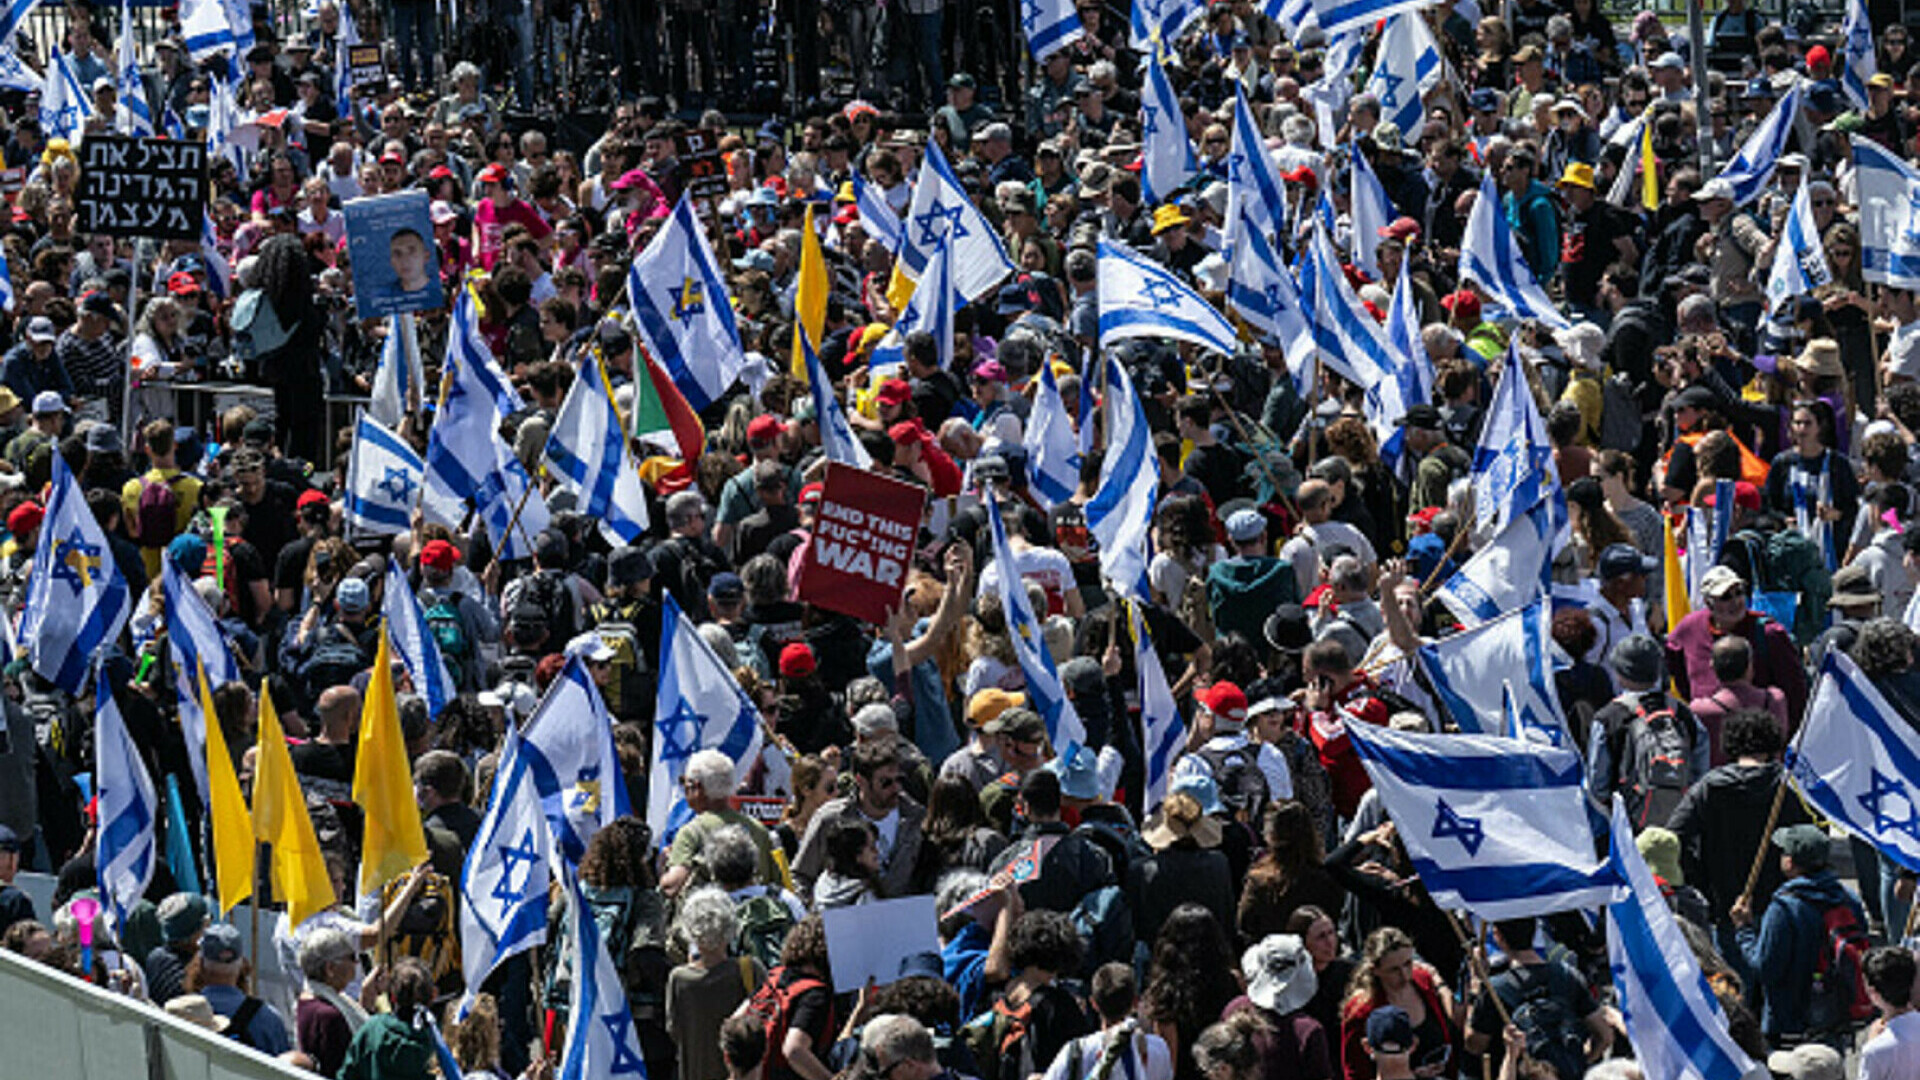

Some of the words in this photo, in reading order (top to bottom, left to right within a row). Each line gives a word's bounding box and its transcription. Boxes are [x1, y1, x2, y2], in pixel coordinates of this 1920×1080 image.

[84, 141, 130, 168] את
[137, 138, 200, 169] תציל
[87, 170, 199, 200] המדינה
[80, 199, 190, 231] מעצמך
[822, 500, 864, 524] END
[867, 513, 913, 541] THIS
[815, 536, 902, 589] WAR
